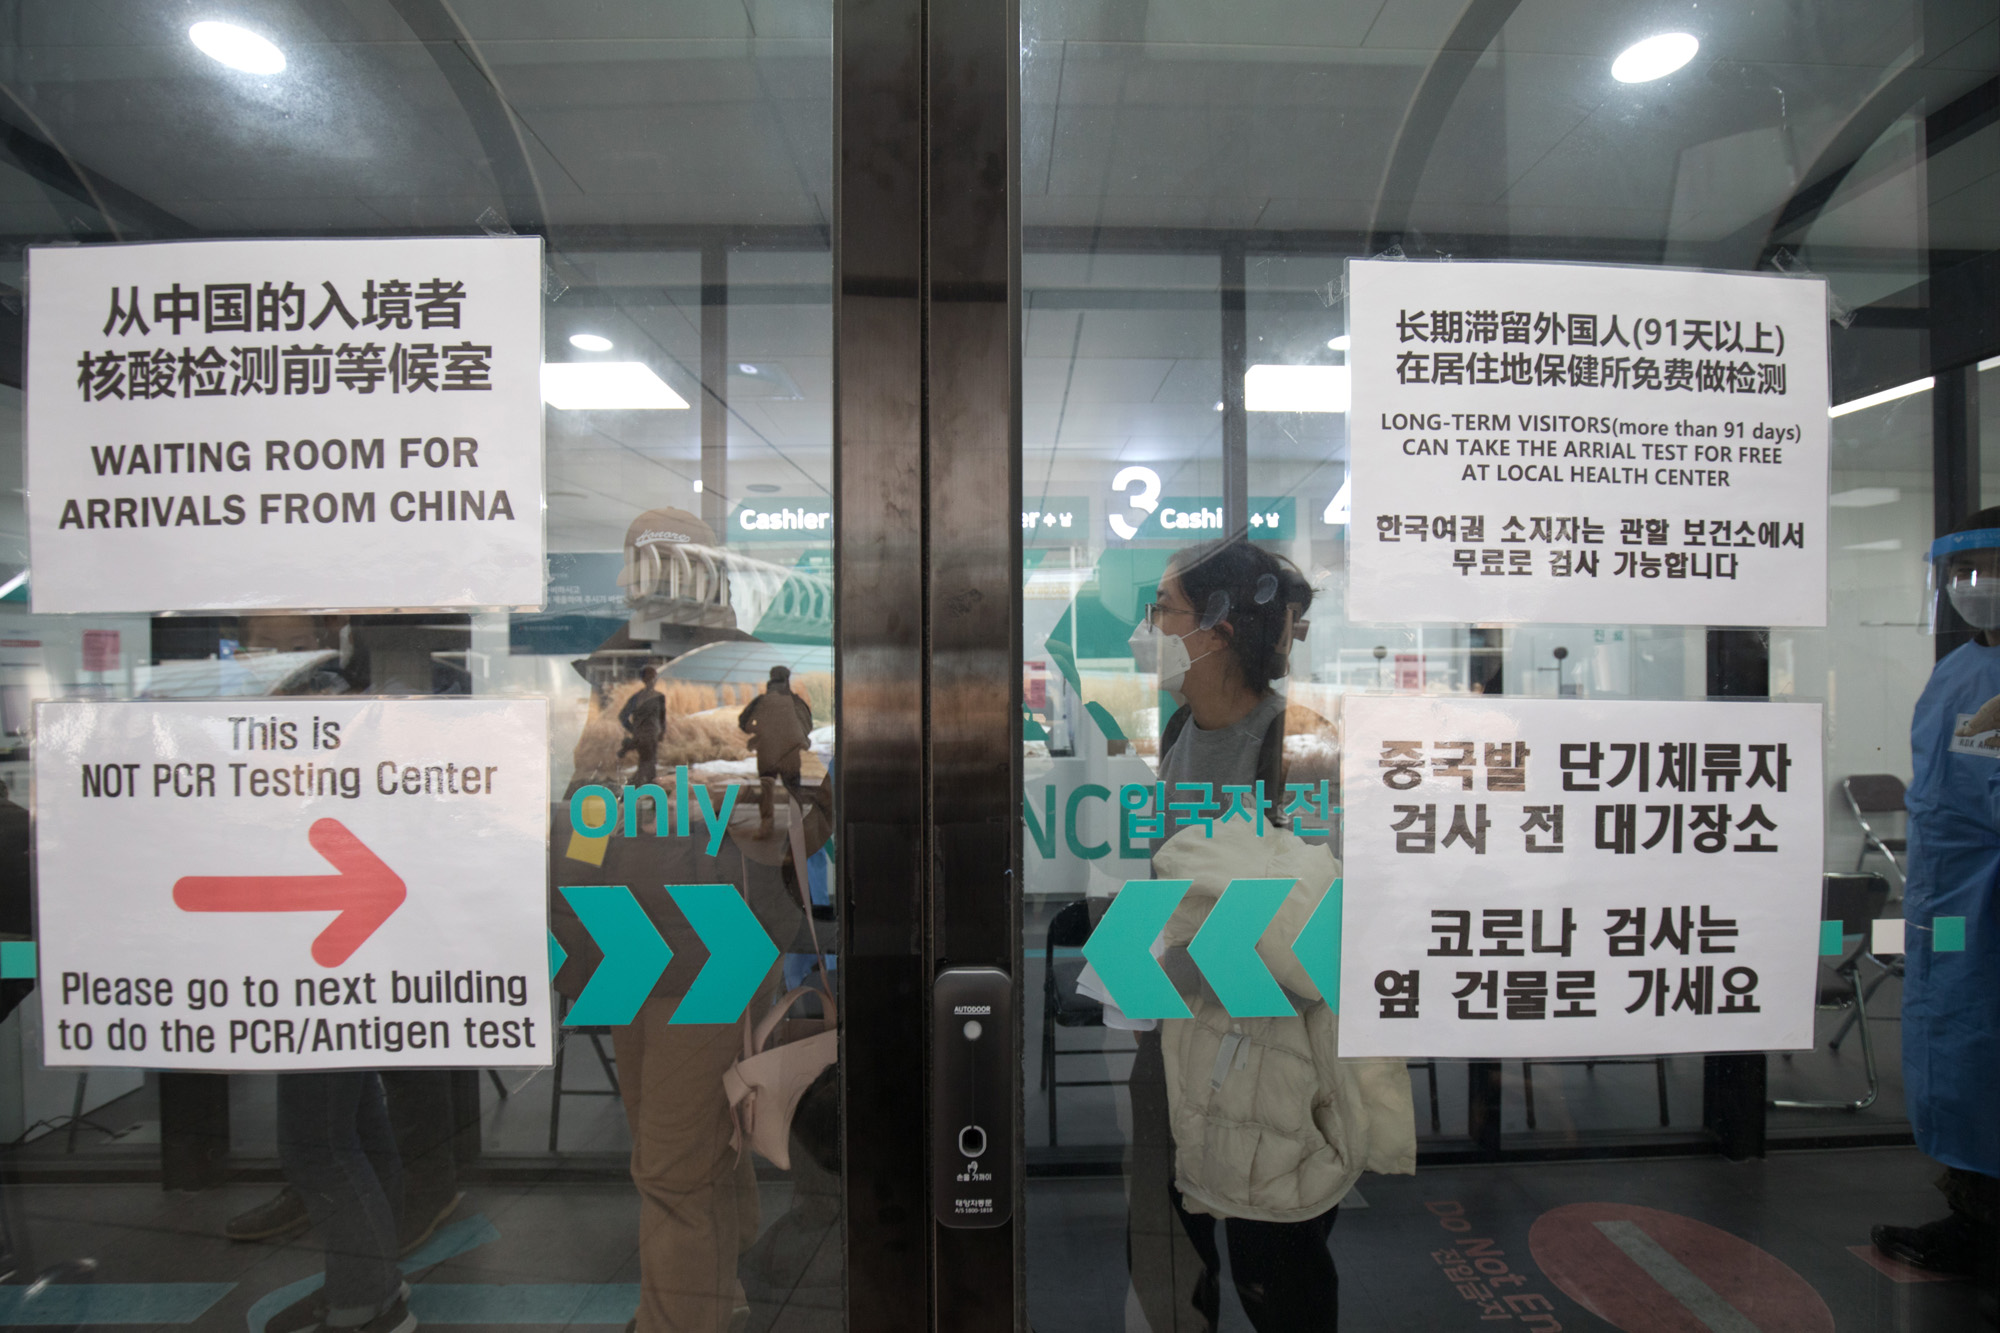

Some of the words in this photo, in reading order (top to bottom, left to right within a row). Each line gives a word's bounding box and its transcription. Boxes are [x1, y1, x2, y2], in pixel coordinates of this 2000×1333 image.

[103, 278, 466, 337] 从中国的入境者
[1396, 310, 1784, 356] 长期滞留外国人(91天以上)
[77, 341, 491, 402] 核酸检测前等候室
[1397, 351, 1786, 395] 在居住地保健所免费做检测
[1382, 414, 1510, 431] LONG-TERM
[1675, 420, 1714, 438] than
[1724, 422, 1744, 438] 91
[1753, 423, 1801, 443] days)
[91, 441, 250, 476] WAITING
[266, 439, 384, 470] ROOM
[401, 437, 478, 468] FOR
[1403, 439, 1448, 455] CAN
[1456, 439, 1510, 456] TAKE
[1517, 440, 1557, 456] THE
[1564, 441, 1633, 459] ARRIAL
[1642, 444, 1688, 460] TEST
[1695, 445, 1732, 462] FOR
[1738, 446, 1782, 463] FREE
[1462, 464, 1490, 480] AT
[1498, 465, 1563, 482] LOCAL
[1571, 466, 1647, 484] HEALTH
[1655, 469, 1730, 486] CENTER
[59, 495, 245, 529] ARRIVALS
[261, 492, 375, 524] FROM
[390, 491, 514, 522] CHINA
[740, 508, 830, 530] Cashier
[1109, 466, 1161, 540] 3
[1160, 508, 1222, 529] Cashi
[1377, 515, 1484, 542] 한국여권
[1501, 516, 1604, 544] 소지자는
[1620, 519, 1669, 545] 관할
[1684, 520, 1803, 548] 보건소에서
[1453, 550, 1532, 576] 무료로
[1550, 550, 1599, 577] 검사
[1614, 552, 1738, 579] 가능합니다
[228, 717, 297, 750] This
[314, 716, 340, 749] is
[83, 764, 140, 797] NOT
[154, 763, 215, 797] PCR
[229, 763, 360, 799] Testing
[377, 761, 497, 795] Center
[1379, 741, 1530, 791] 중국발
[1560, 742, 1791, 792] 단기체류자
[570, 765, 740, 857] only
[1120, 780, 1272, 838] 입국자
[1283, 779, 1344, 837] 전
[1390, 804, 1491, 854] 검사
[1520, 805, 1563, 853] 전
[1595, 804, 1778, 854] 대기장소
[1427, 908, 1577, 957] 코로나
[1604, 905, 1738, 957] 검사는
[63, 972, 172, 1006] Please
[188, 979, 228, 1010] go
[243, 976, 278, 1007] to
[296, 973, 376, 1006] next
[392, 971, 527, 1006] building
[954, 1005, 991, 1013] AUTODOOR
[1374, 970, 1419, 1018] 옆
[1452, 970, 1596, 1020] 건물로
[1625, 966, 1760, 1016] 가세요
[59, 1019, 92, 1050] to
[108, 1018, 146, 1051] do
[161, 1019, 214, 1053] the
[230, 1017, 449, 1054] PCR/Antigen
[464, 1017, 535, 1048] test
[1424, 1200, 1472, 1232] Do
[1454, 1238, 1527, 1288] Not
[1430, 1248, 1513, 1320] 진입금지
